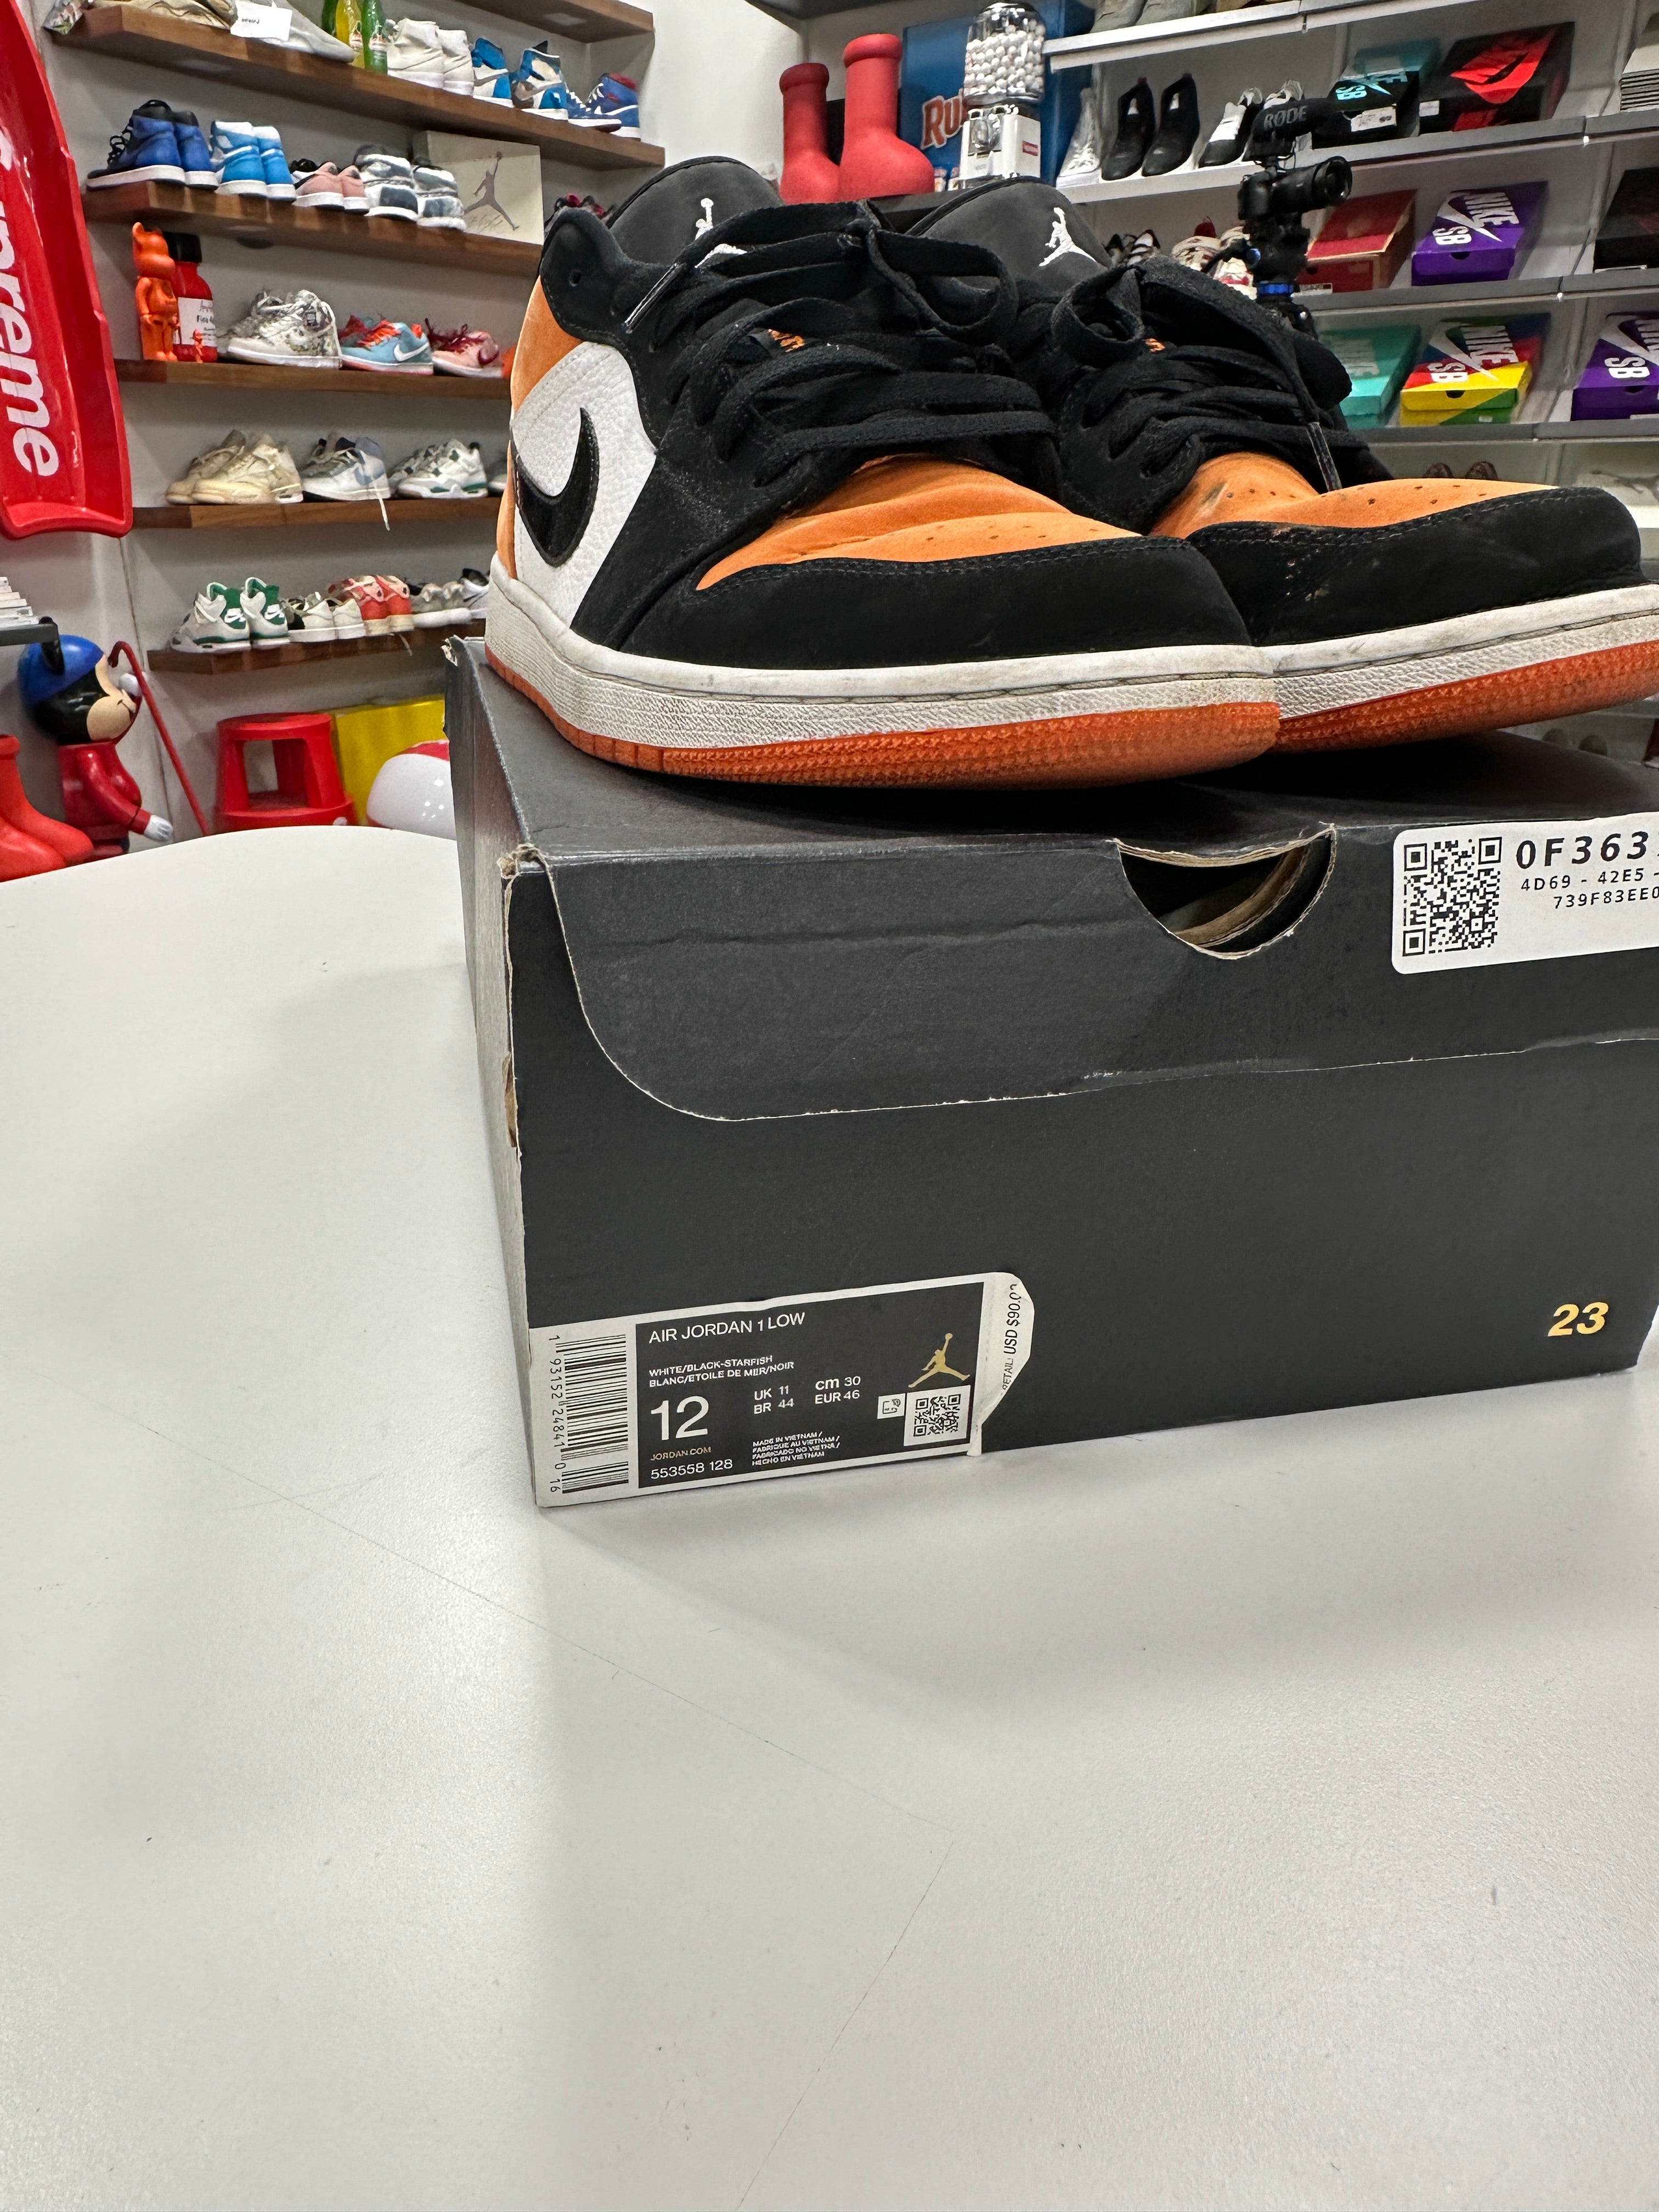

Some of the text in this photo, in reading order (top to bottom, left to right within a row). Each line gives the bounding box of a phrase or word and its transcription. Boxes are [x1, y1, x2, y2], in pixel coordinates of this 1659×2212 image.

[1463, 191, 1519, 228] NIKE
[1432, 225, 1472, 245] SB
[1460, 325, 1519, 369] NIKE
[1427, 361, 1469, 383] SB
[1604, 357, 1650, 379] SB
[1516, 831, 1659, 869] 0F363
[1521, 874, 1571, 891] 4D69
[1597, 867, 1644, 884] 42E5
[648, 1312, 805, 1344] AIR JORDAN 1 LOW
[1547, 1302, 1609, 1337] 23
[1003, 1329, 1018, 1354] USD
[649, 1355, 773, 1377] WHITE/BLACK-STARFISH
[550, 1358, 563, 1399] 93152
[649, 1369, 725, 1387] BLANC/ETOILE
[727, 1369, 741, 1378] DE
[815, 1376, 861, 1391] cm 30
[754, 1385, 789, 1401] UK 11
[815, 1390, 860, 1404] EUR 46
[754, 1398, 794, 1414] BR 44
[552, 1408, 566, 1447] 24841
[651, 1396, 709, 1441] 12
[650, 1446, 712, 1461] JORDAN.COM
[651, 1459, 733, 1479] 553558 128
